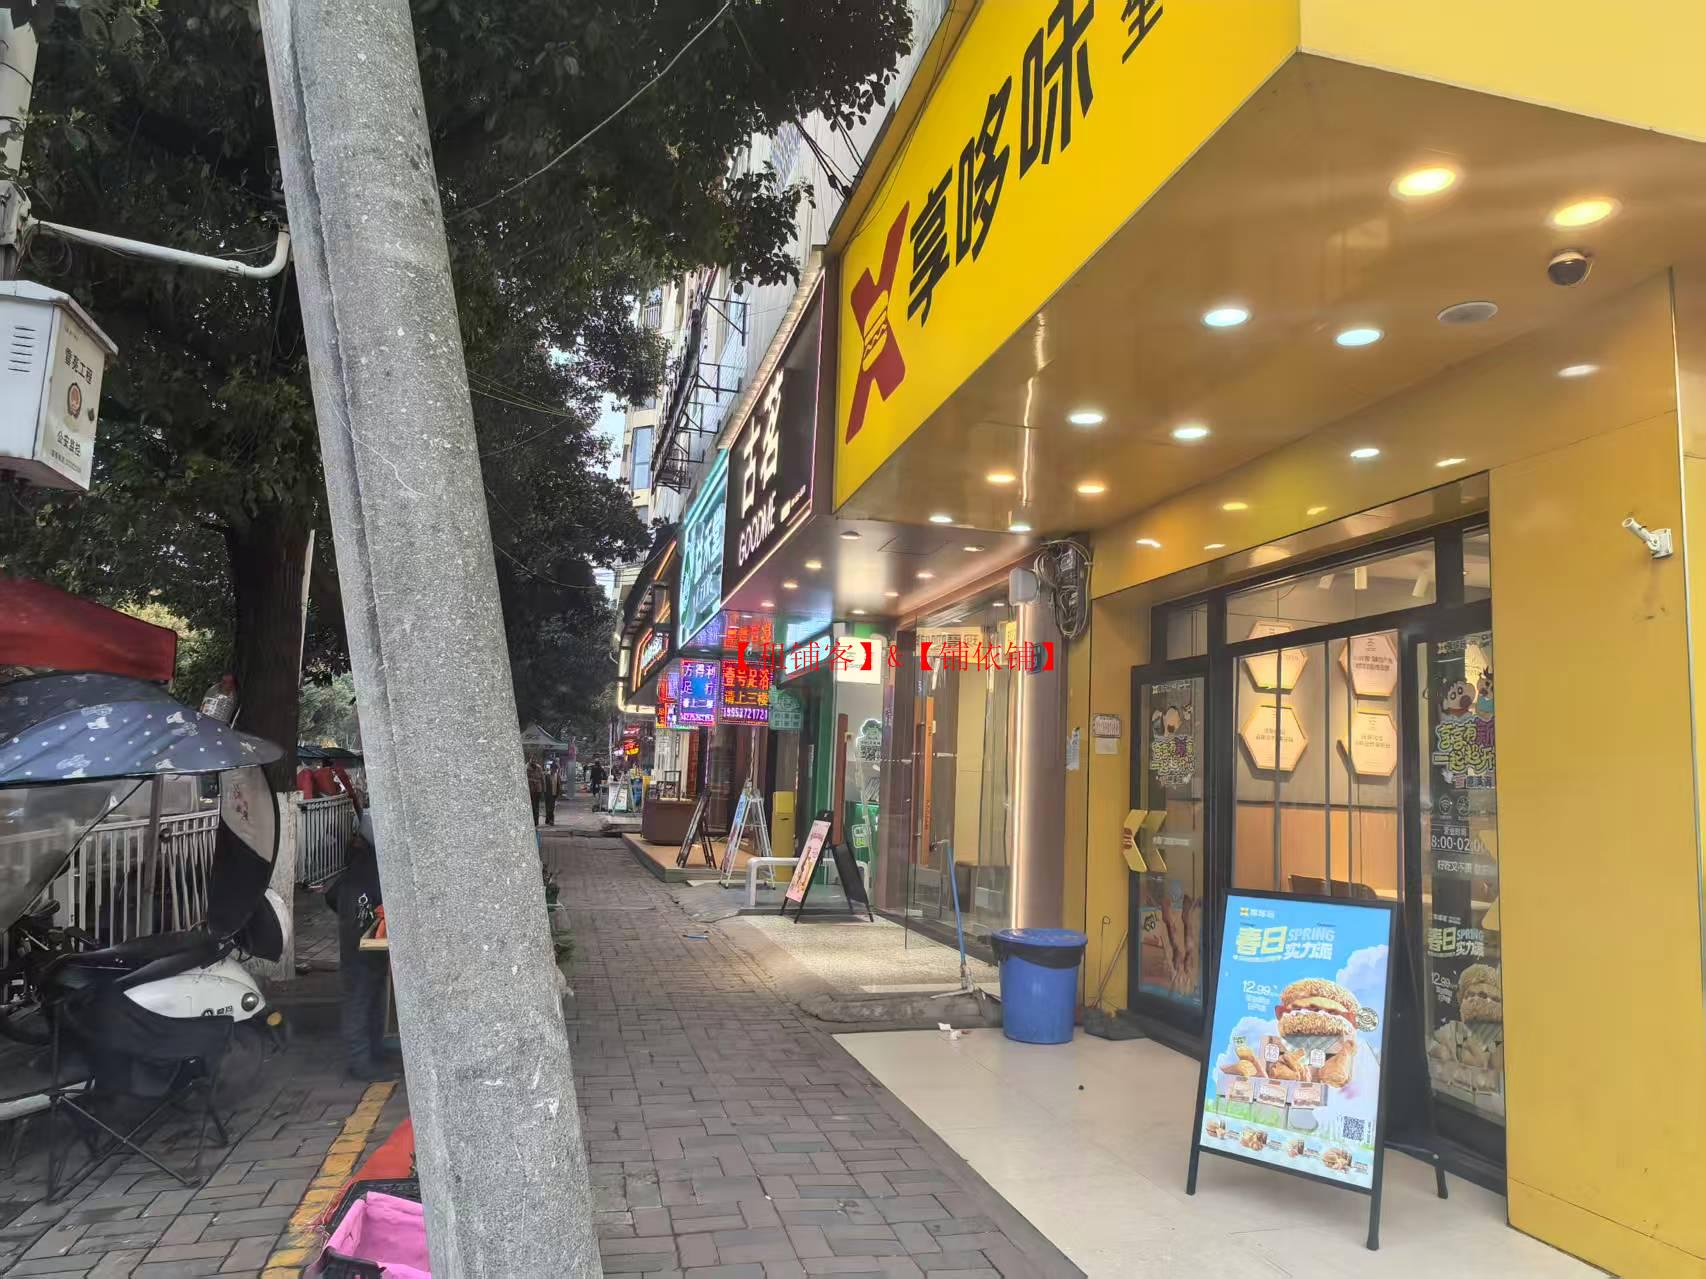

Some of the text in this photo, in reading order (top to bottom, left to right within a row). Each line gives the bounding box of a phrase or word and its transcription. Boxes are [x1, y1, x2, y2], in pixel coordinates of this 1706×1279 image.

[907, 0, 1095, 327] 享哆味
[740, 367, 784, 518] 古茗
[737, 490, 777, 567] GOODME
[724, 667, 769, 690] 壹号足浴
[1235, 926, 1336, 956] 春日 SPRING
[1428, 927, 1484, 952] 春日 SPRING
[1242, 980, 1272, 996] 12.99
